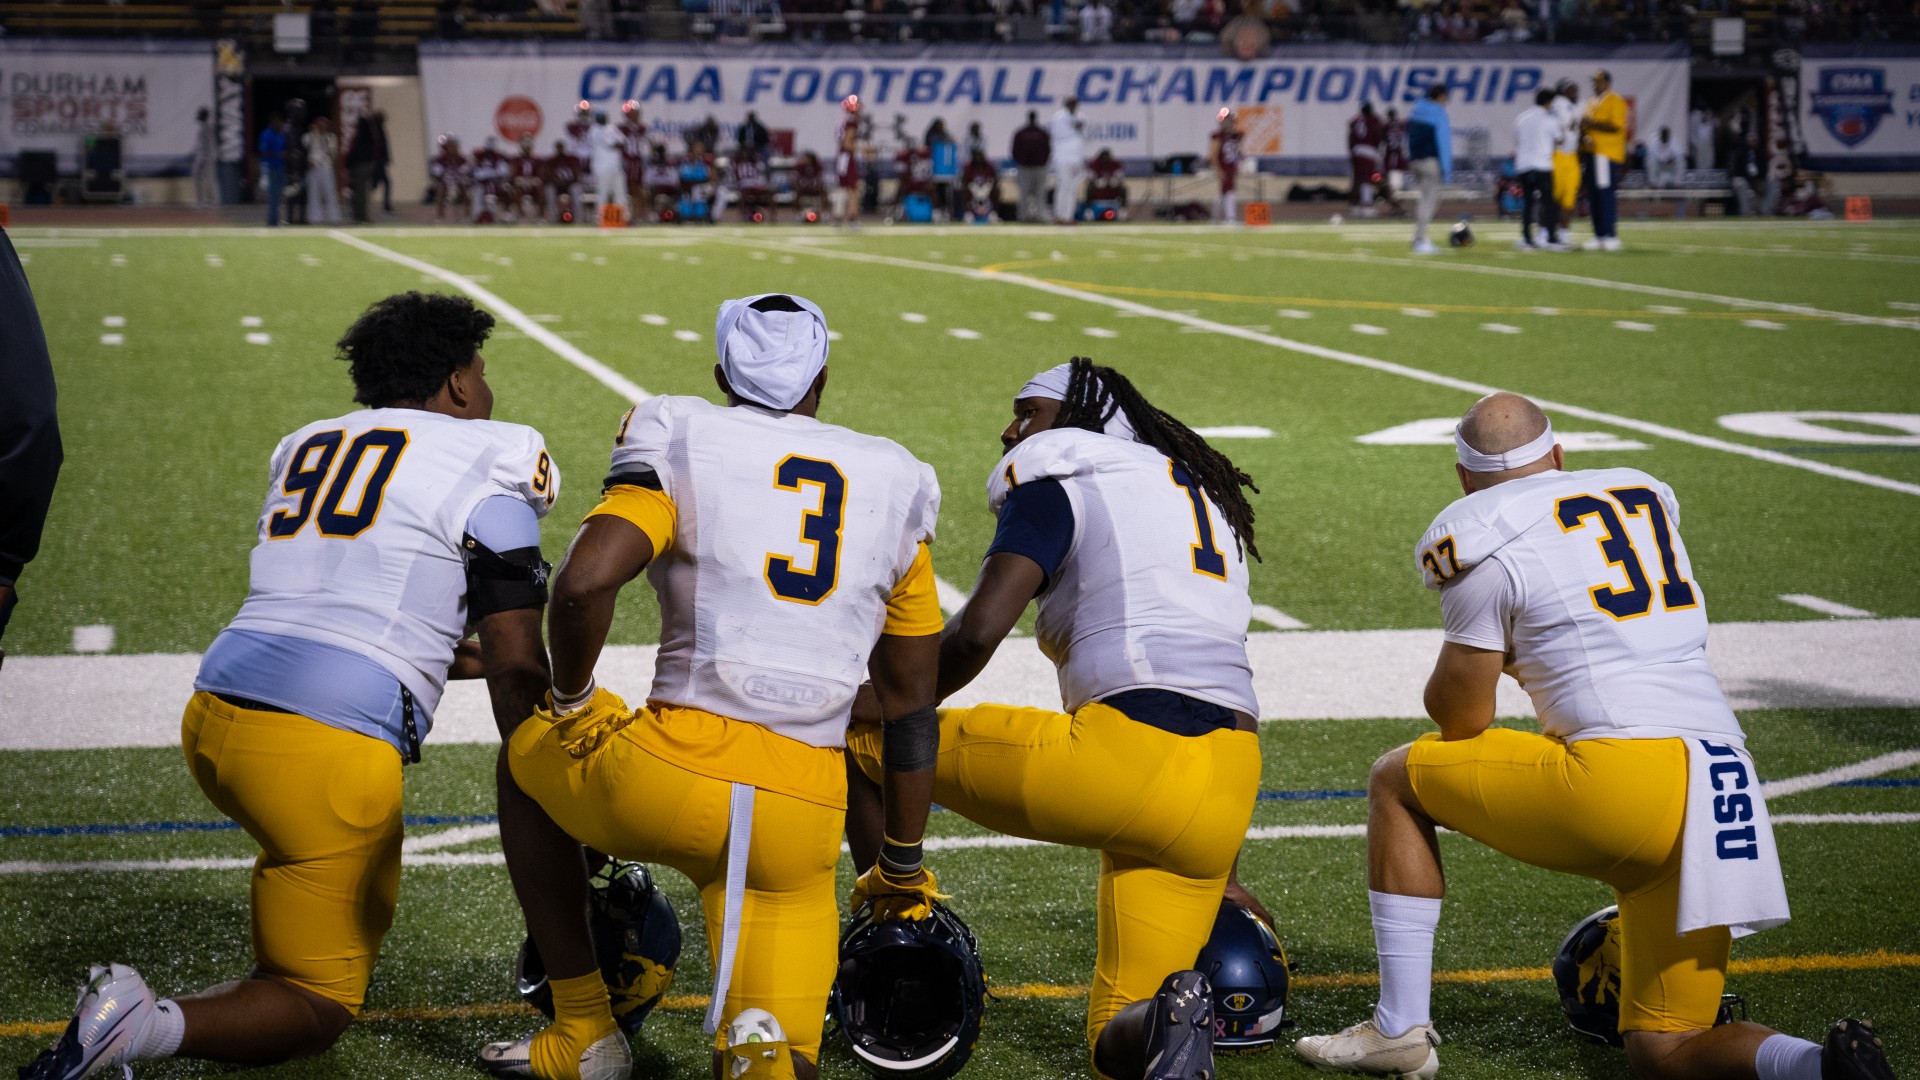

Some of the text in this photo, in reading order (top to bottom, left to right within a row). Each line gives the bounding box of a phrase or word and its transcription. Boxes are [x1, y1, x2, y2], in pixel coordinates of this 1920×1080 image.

[11, 71, 147, 95] DURHAM
[11, 95, 148, 121] SPORTS
[579, 65, 1543, 104] CIAA FOOTBALL CHAMPIONSHIP
[267, 427, 411, 540] 90
[1004, 461, 1020, 490] 1
[763, 452, 849, 607] 3
[1167, 459, 1228, 583] 1
[1421, 533, 1463, 586] 37
[1553, 485, 1699, 622] 37
